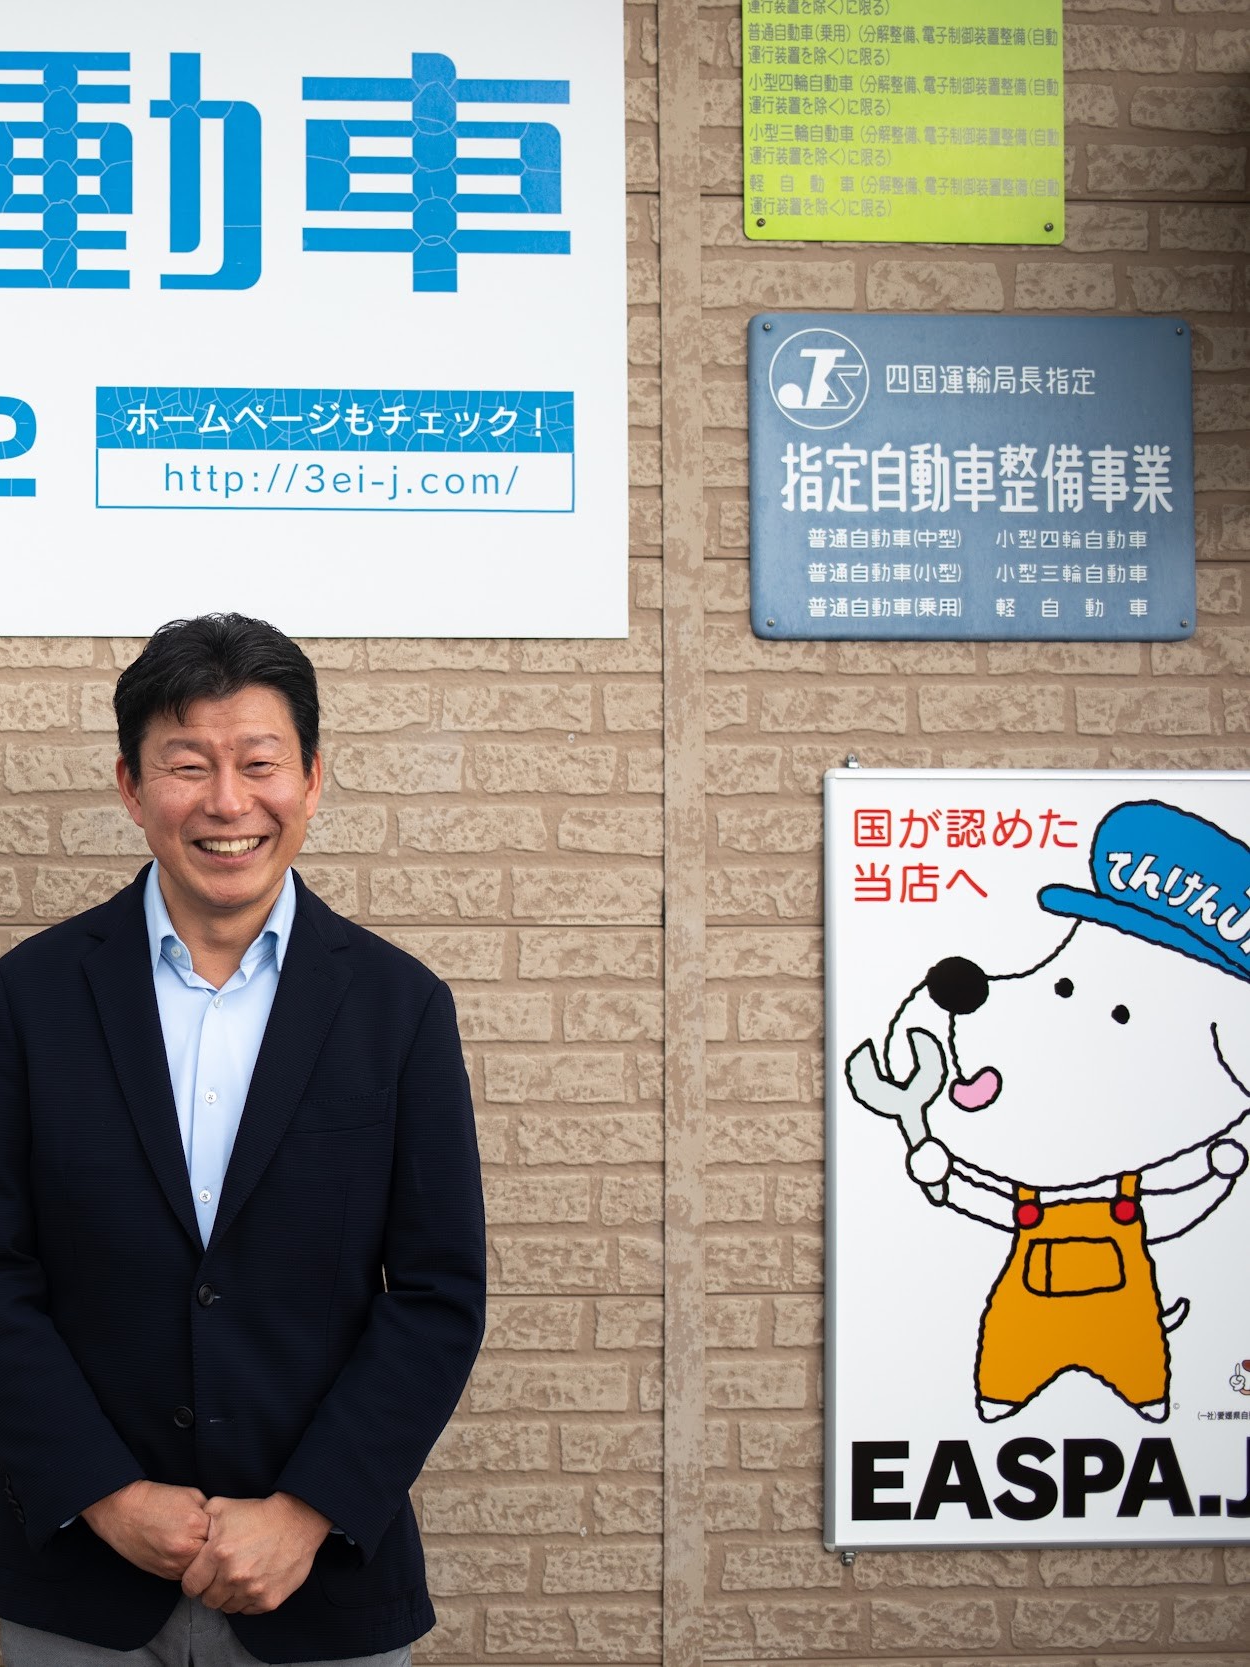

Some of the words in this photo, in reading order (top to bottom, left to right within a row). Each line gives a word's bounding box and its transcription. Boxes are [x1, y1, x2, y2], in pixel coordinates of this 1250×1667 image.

[886, 365, 1095, 395] 四国運輸局長指定
[125, 402, 544, 438] ホームページもチェック！
[164, 463, 519, 501] http://3ei-j.com/
[781, 442, 1173, 514] 指定自動車整備事業
[808, 528, 962, 548] 普通自動車(中型)
[996, 529, 1148, 549] 小型四輪自動車
[808, 562, 962, 583] 普通自動車(小型)
[996, 563, 1148, 583] 小型三輪自動車
[808, 597, 962, 617] 普通自動車(乗用)
[854, 808, 1078, 848] 国が認めた
[854, 862, 988, 903] 当店へ
[1197, 1411, 1250, 1421] (一社)愛媛県自
